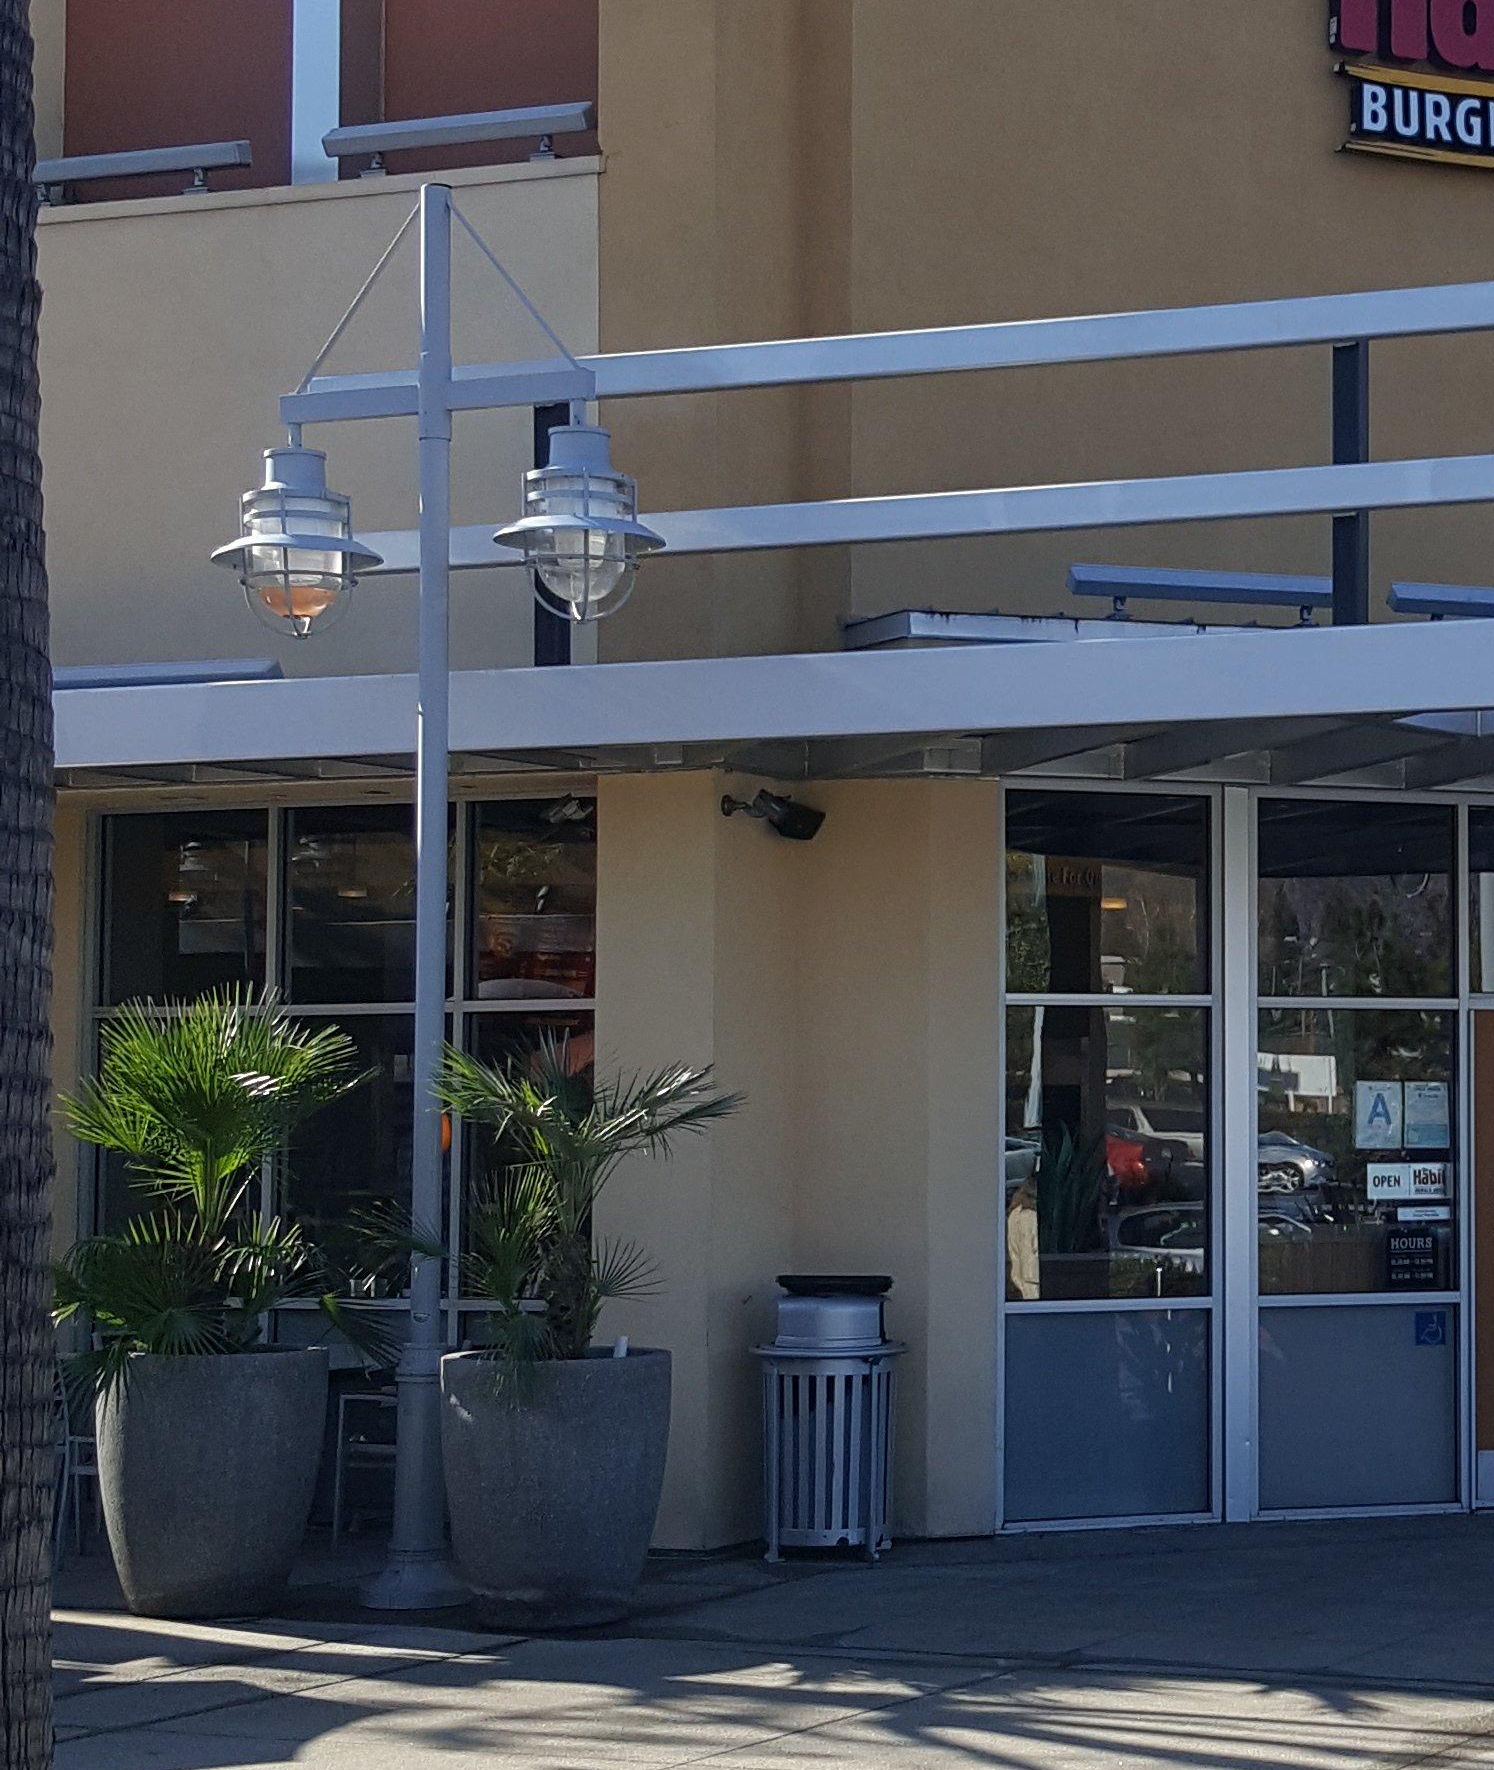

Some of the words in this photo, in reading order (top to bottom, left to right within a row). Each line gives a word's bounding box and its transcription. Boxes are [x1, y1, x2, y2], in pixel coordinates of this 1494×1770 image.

[1367, 1092, 1392, 1126] A
[1372, 1175, 1401, 1189] OPEN
[1390, 1236, 1433, 1249] HOURS
